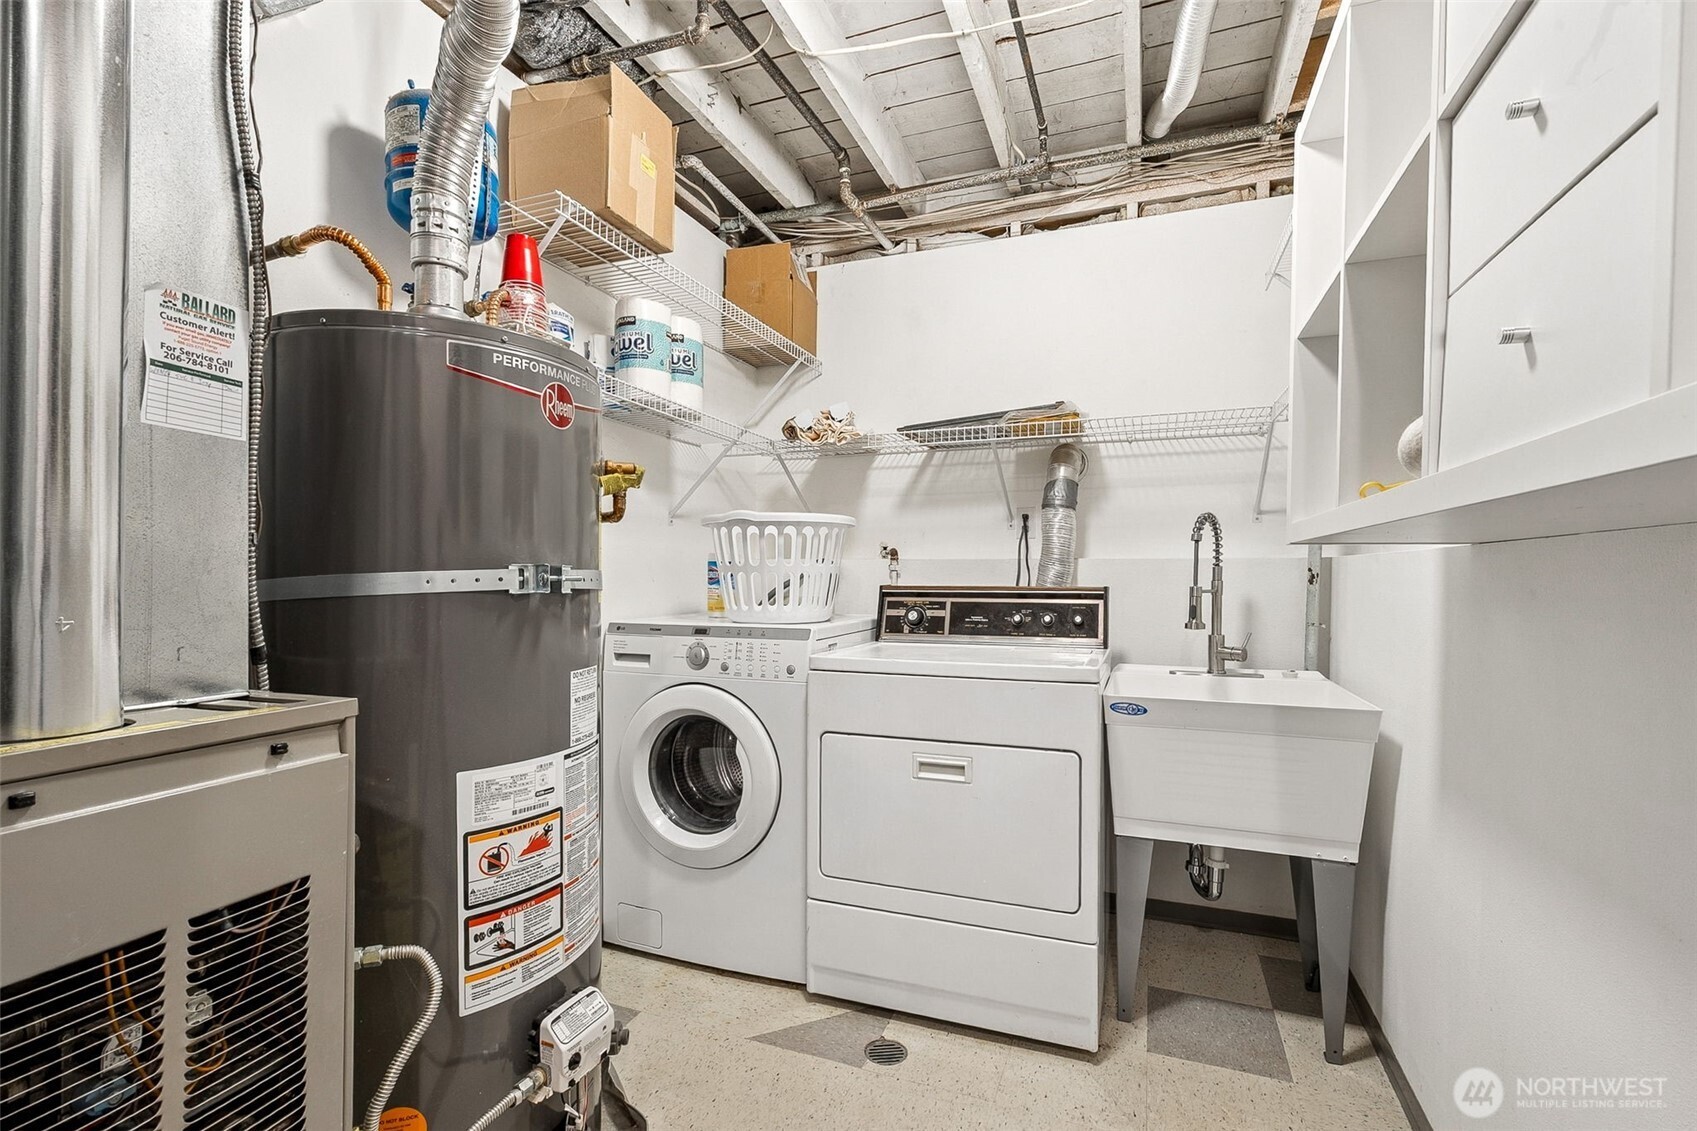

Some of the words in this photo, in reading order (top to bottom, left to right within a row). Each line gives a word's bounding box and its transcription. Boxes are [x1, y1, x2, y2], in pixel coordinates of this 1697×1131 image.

[160, 303, 191, 317] NATURAL
[193, 314, 208, 322] GAS
[210, 318, 236, 330] SERVICE
[182, 292, 236, 324] BALLARD
[160, 311, 208, 332] Customer
[210, 326, 236, 340] Alert!
[160, 342, 178, 352] For
[180, 346, 214, 364] Service
[216, 357, 233, 368] Call
[164, 350, 229, 374] 206-784-8101
[492, 352, 581, 388] PERFORMANCE
[546, 383, 573, 422] Rheem
[506, 820, 540, 835] WARNING
[508, 900, 536, 916] DANGER
[508, 950, 538, 969] WARNING
[398, 1113, 420, 1122] BLOCK
